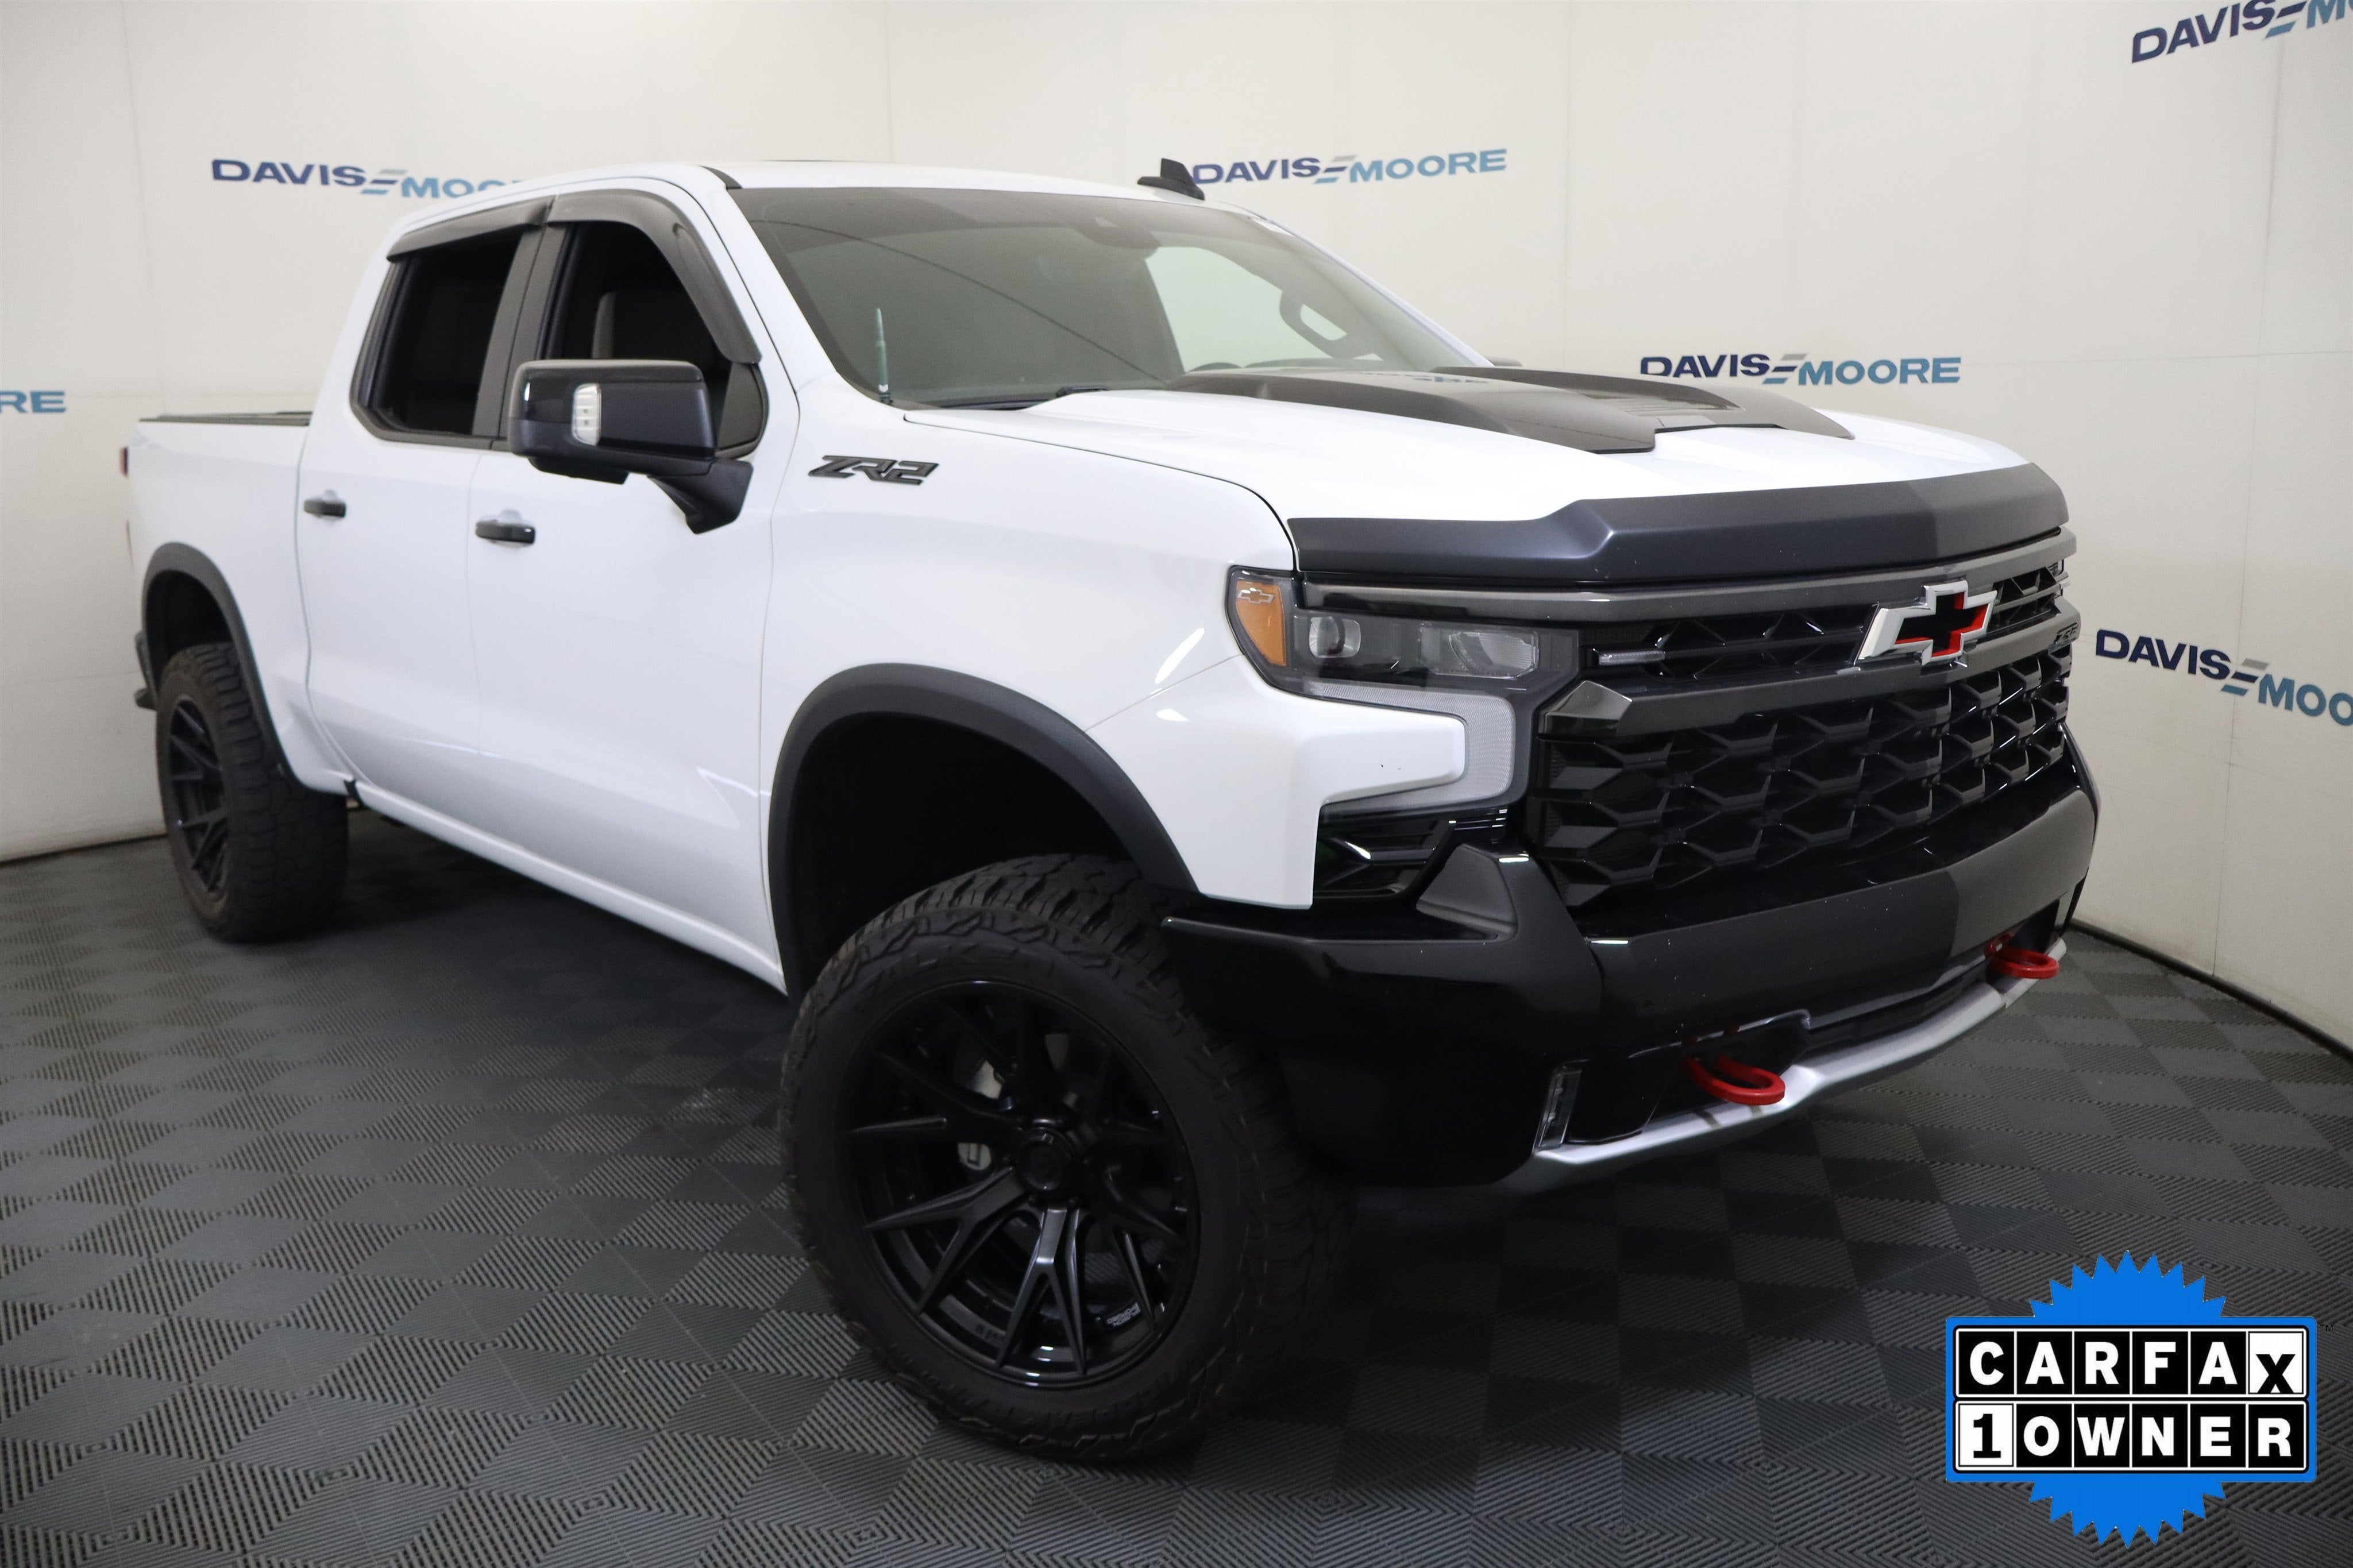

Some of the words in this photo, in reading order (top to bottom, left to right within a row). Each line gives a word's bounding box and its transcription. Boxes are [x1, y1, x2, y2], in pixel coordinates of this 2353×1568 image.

[2132, 0, 2275, 63] DAVIS
[212, 159, 365, 187] DAVIS
[1192, 157, 1320, 184] DAVIS
[1349, 149, 1507, 183] MOORE
[1641, 354, 1770, 378] DAVIS
[1798, 357, 1961, 386] MOORE
[808, 455, 940, 486] ZR2
[2096, 629, 2231, 680] DAVIS
